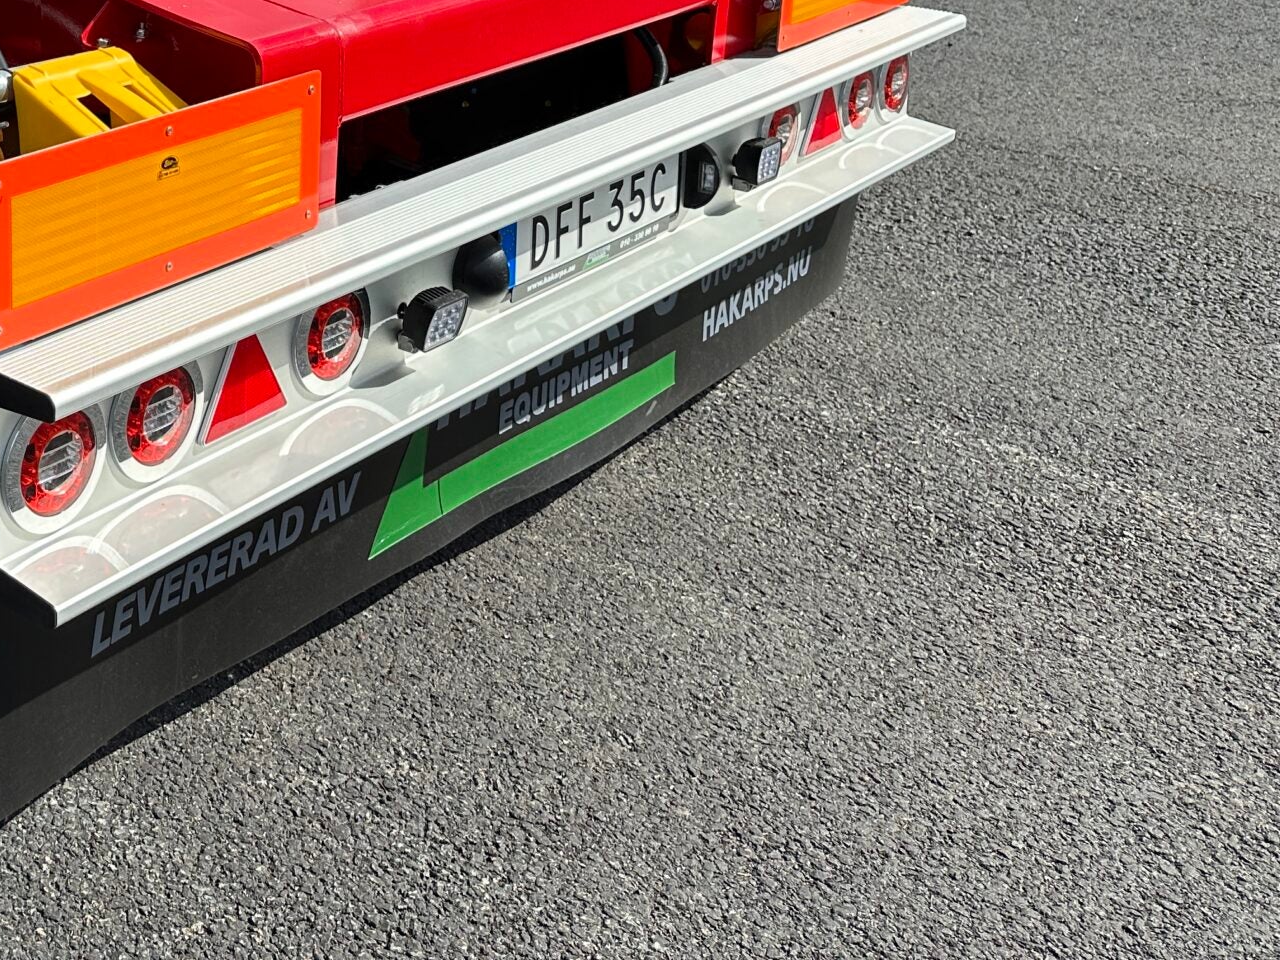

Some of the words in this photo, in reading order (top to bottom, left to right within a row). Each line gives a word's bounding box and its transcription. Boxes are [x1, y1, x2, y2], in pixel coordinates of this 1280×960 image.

[530, 191, 595, 271] DFF
[607, 162, 666, 233] 35C
[702, 245, 813, 343] HAKARPS.NU
[498, 339, 634, 436] EQUIPMENT
[90, 505, 305, 658] LEVERERAD
[310, 470, 362, 534] AV
